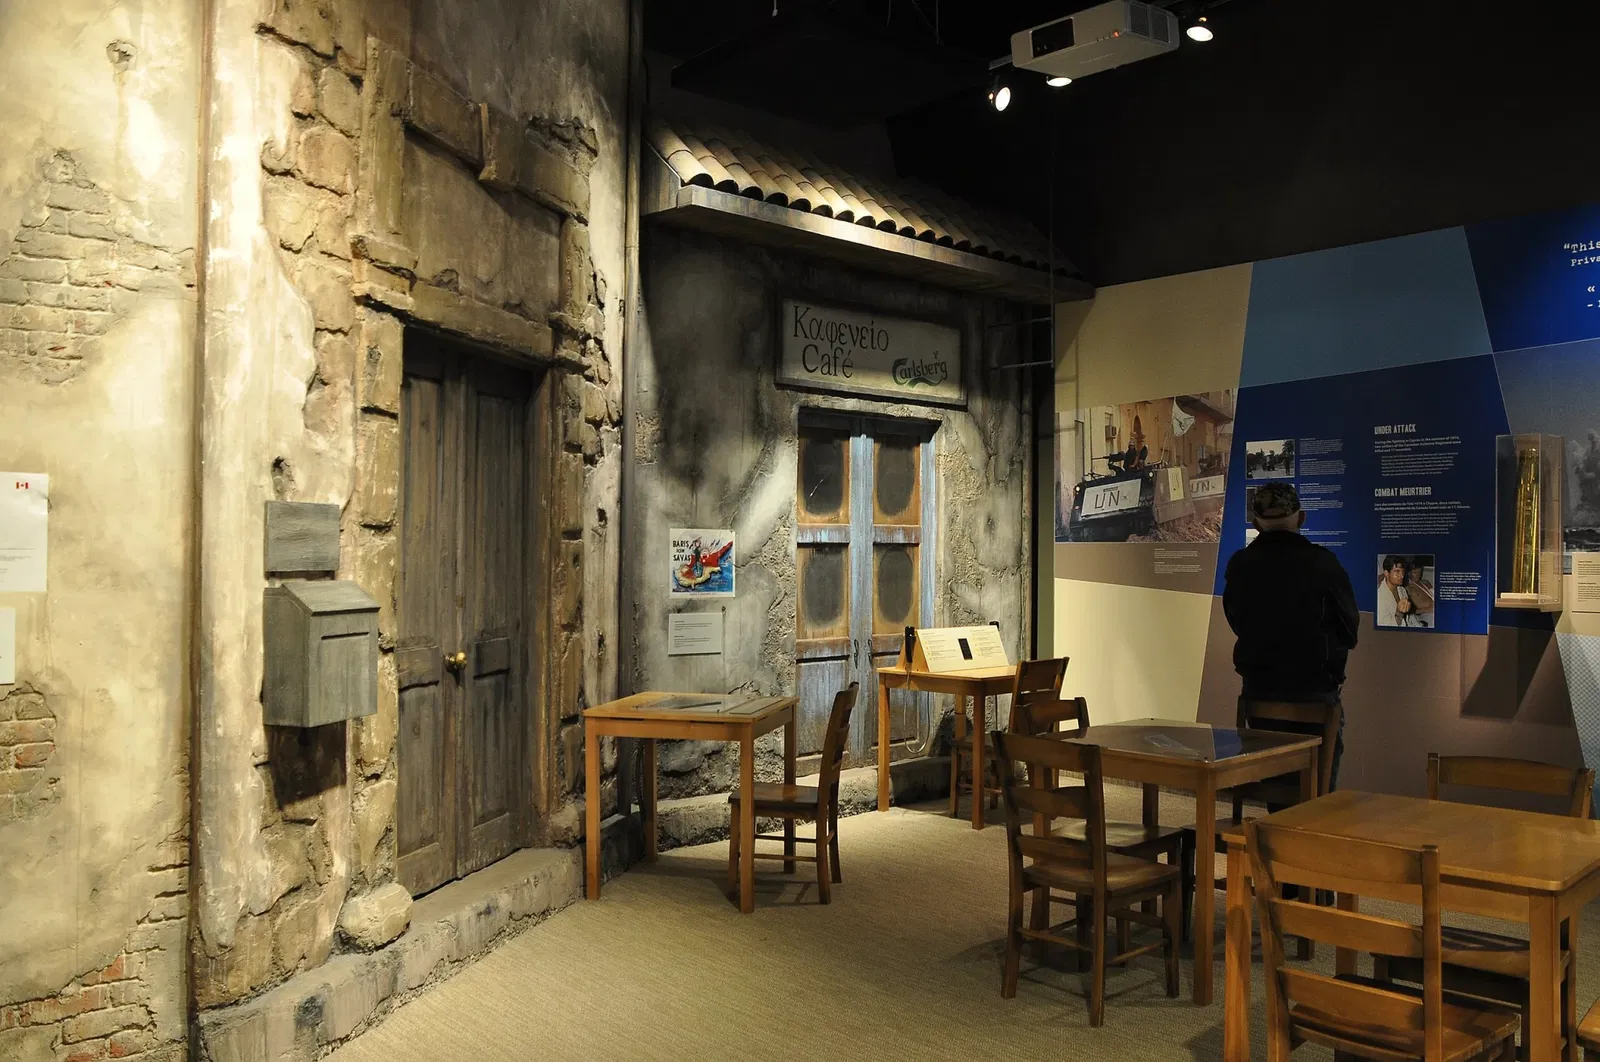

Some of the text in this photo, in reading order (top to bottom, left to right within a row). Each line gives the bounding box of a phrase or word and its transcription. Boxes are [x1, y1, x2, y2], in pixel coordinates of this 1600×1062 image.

[802, 344, 853, 378] Café
[892, 357, 947, 385] Carlsberg
[1374, 424, 1416, 434] UNDER ATTACK
[1190, 480, 1210, 493] UN
[1374, 486, 1432, 497] COMBAT MEURTRIER
[1095, 490, 1120, 509] UN
